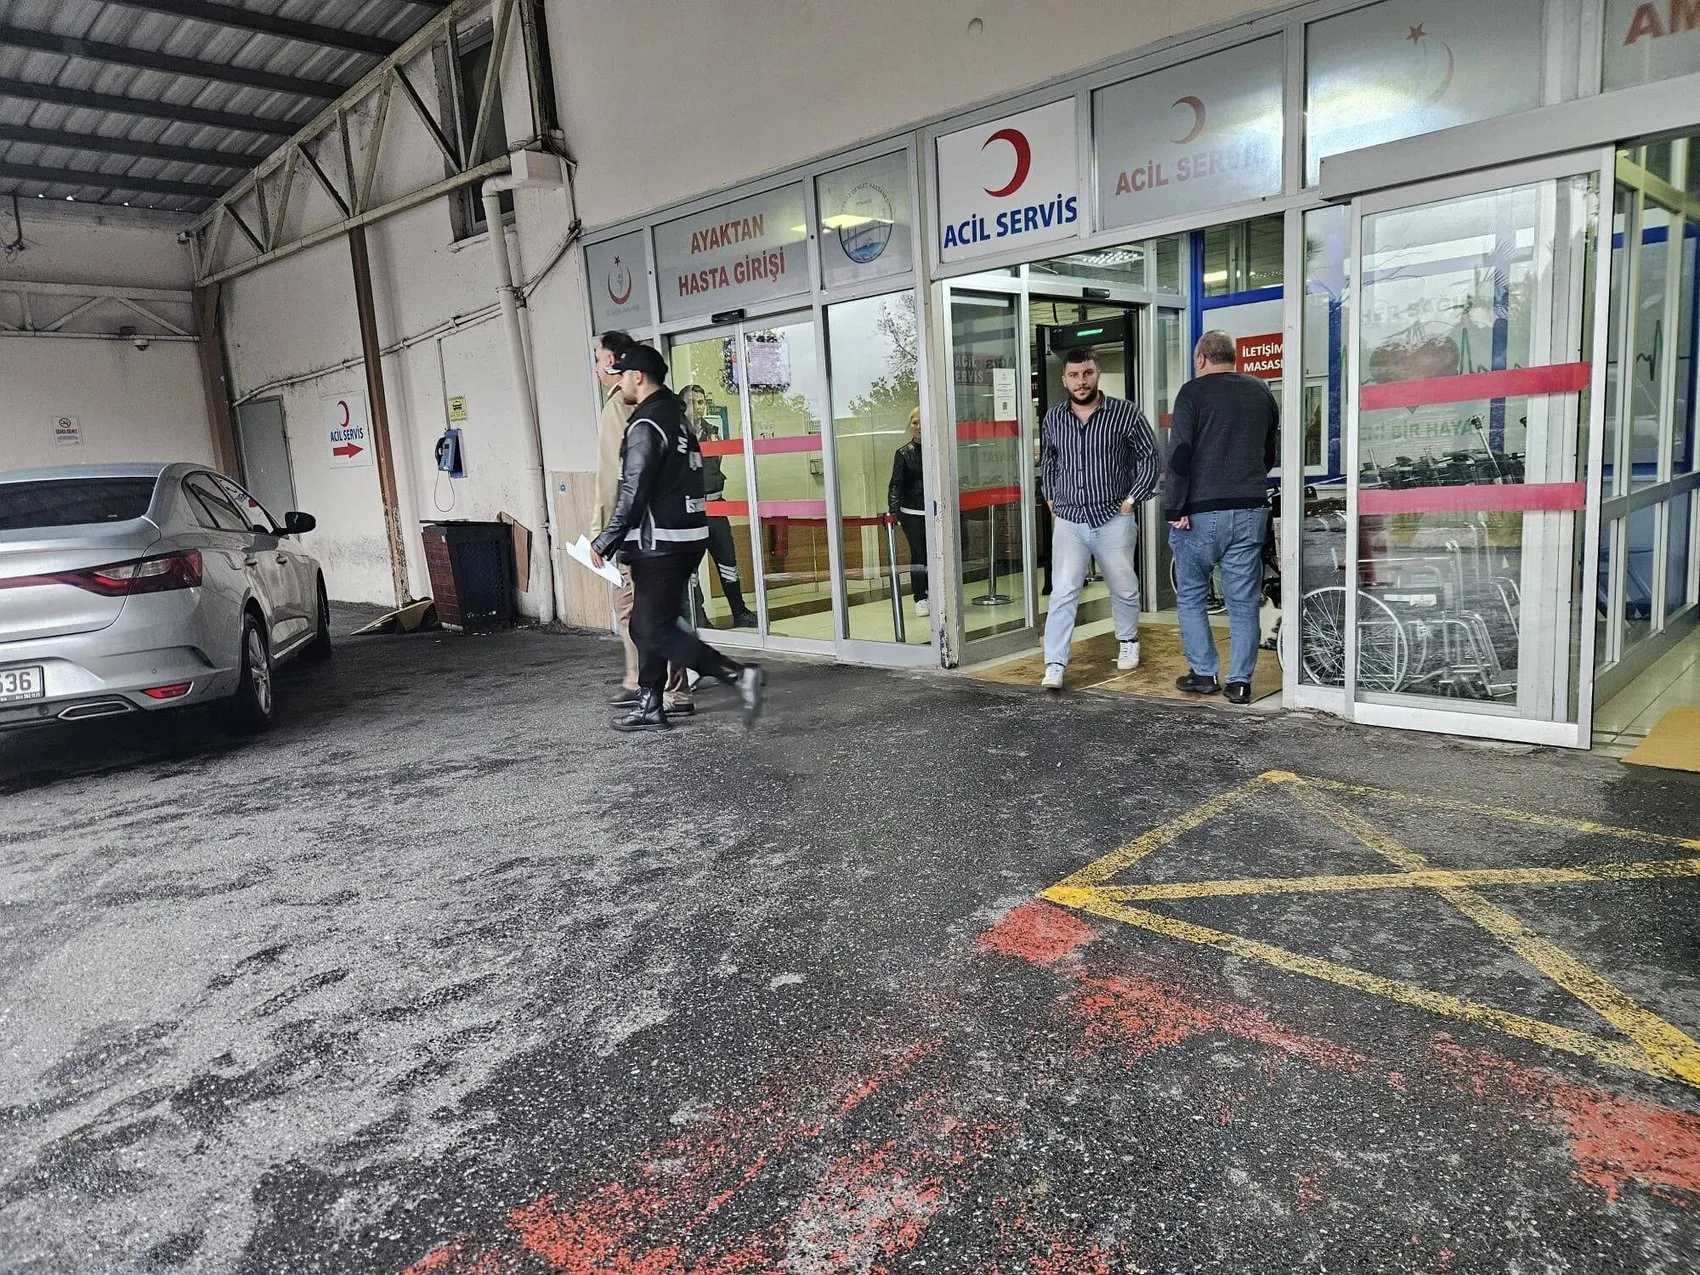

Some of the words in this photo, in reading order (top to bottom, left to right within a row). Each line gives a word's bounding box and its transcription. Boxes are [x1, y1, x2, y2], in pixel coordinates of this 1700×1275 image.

[1115, 160, 1169, 196] ACİL
[690, 213, 765, 255] AYAKTAN
[943, 213, 991, 249] ACİL
[996, 193, 1078, 238] SERVİS
[678, 265, 730, 297] HASTA
[733, 246, 786, 282] GİRİŞİ
[1242, 342, 1284, 358] İLETİŞİM
[1243, 359, 1284, 373] MASASI
[330, 429, 343, 442] ACİL
[343, 425, 363, 440] SERVİS
[1426, 417, 1476, 436] HAYA
